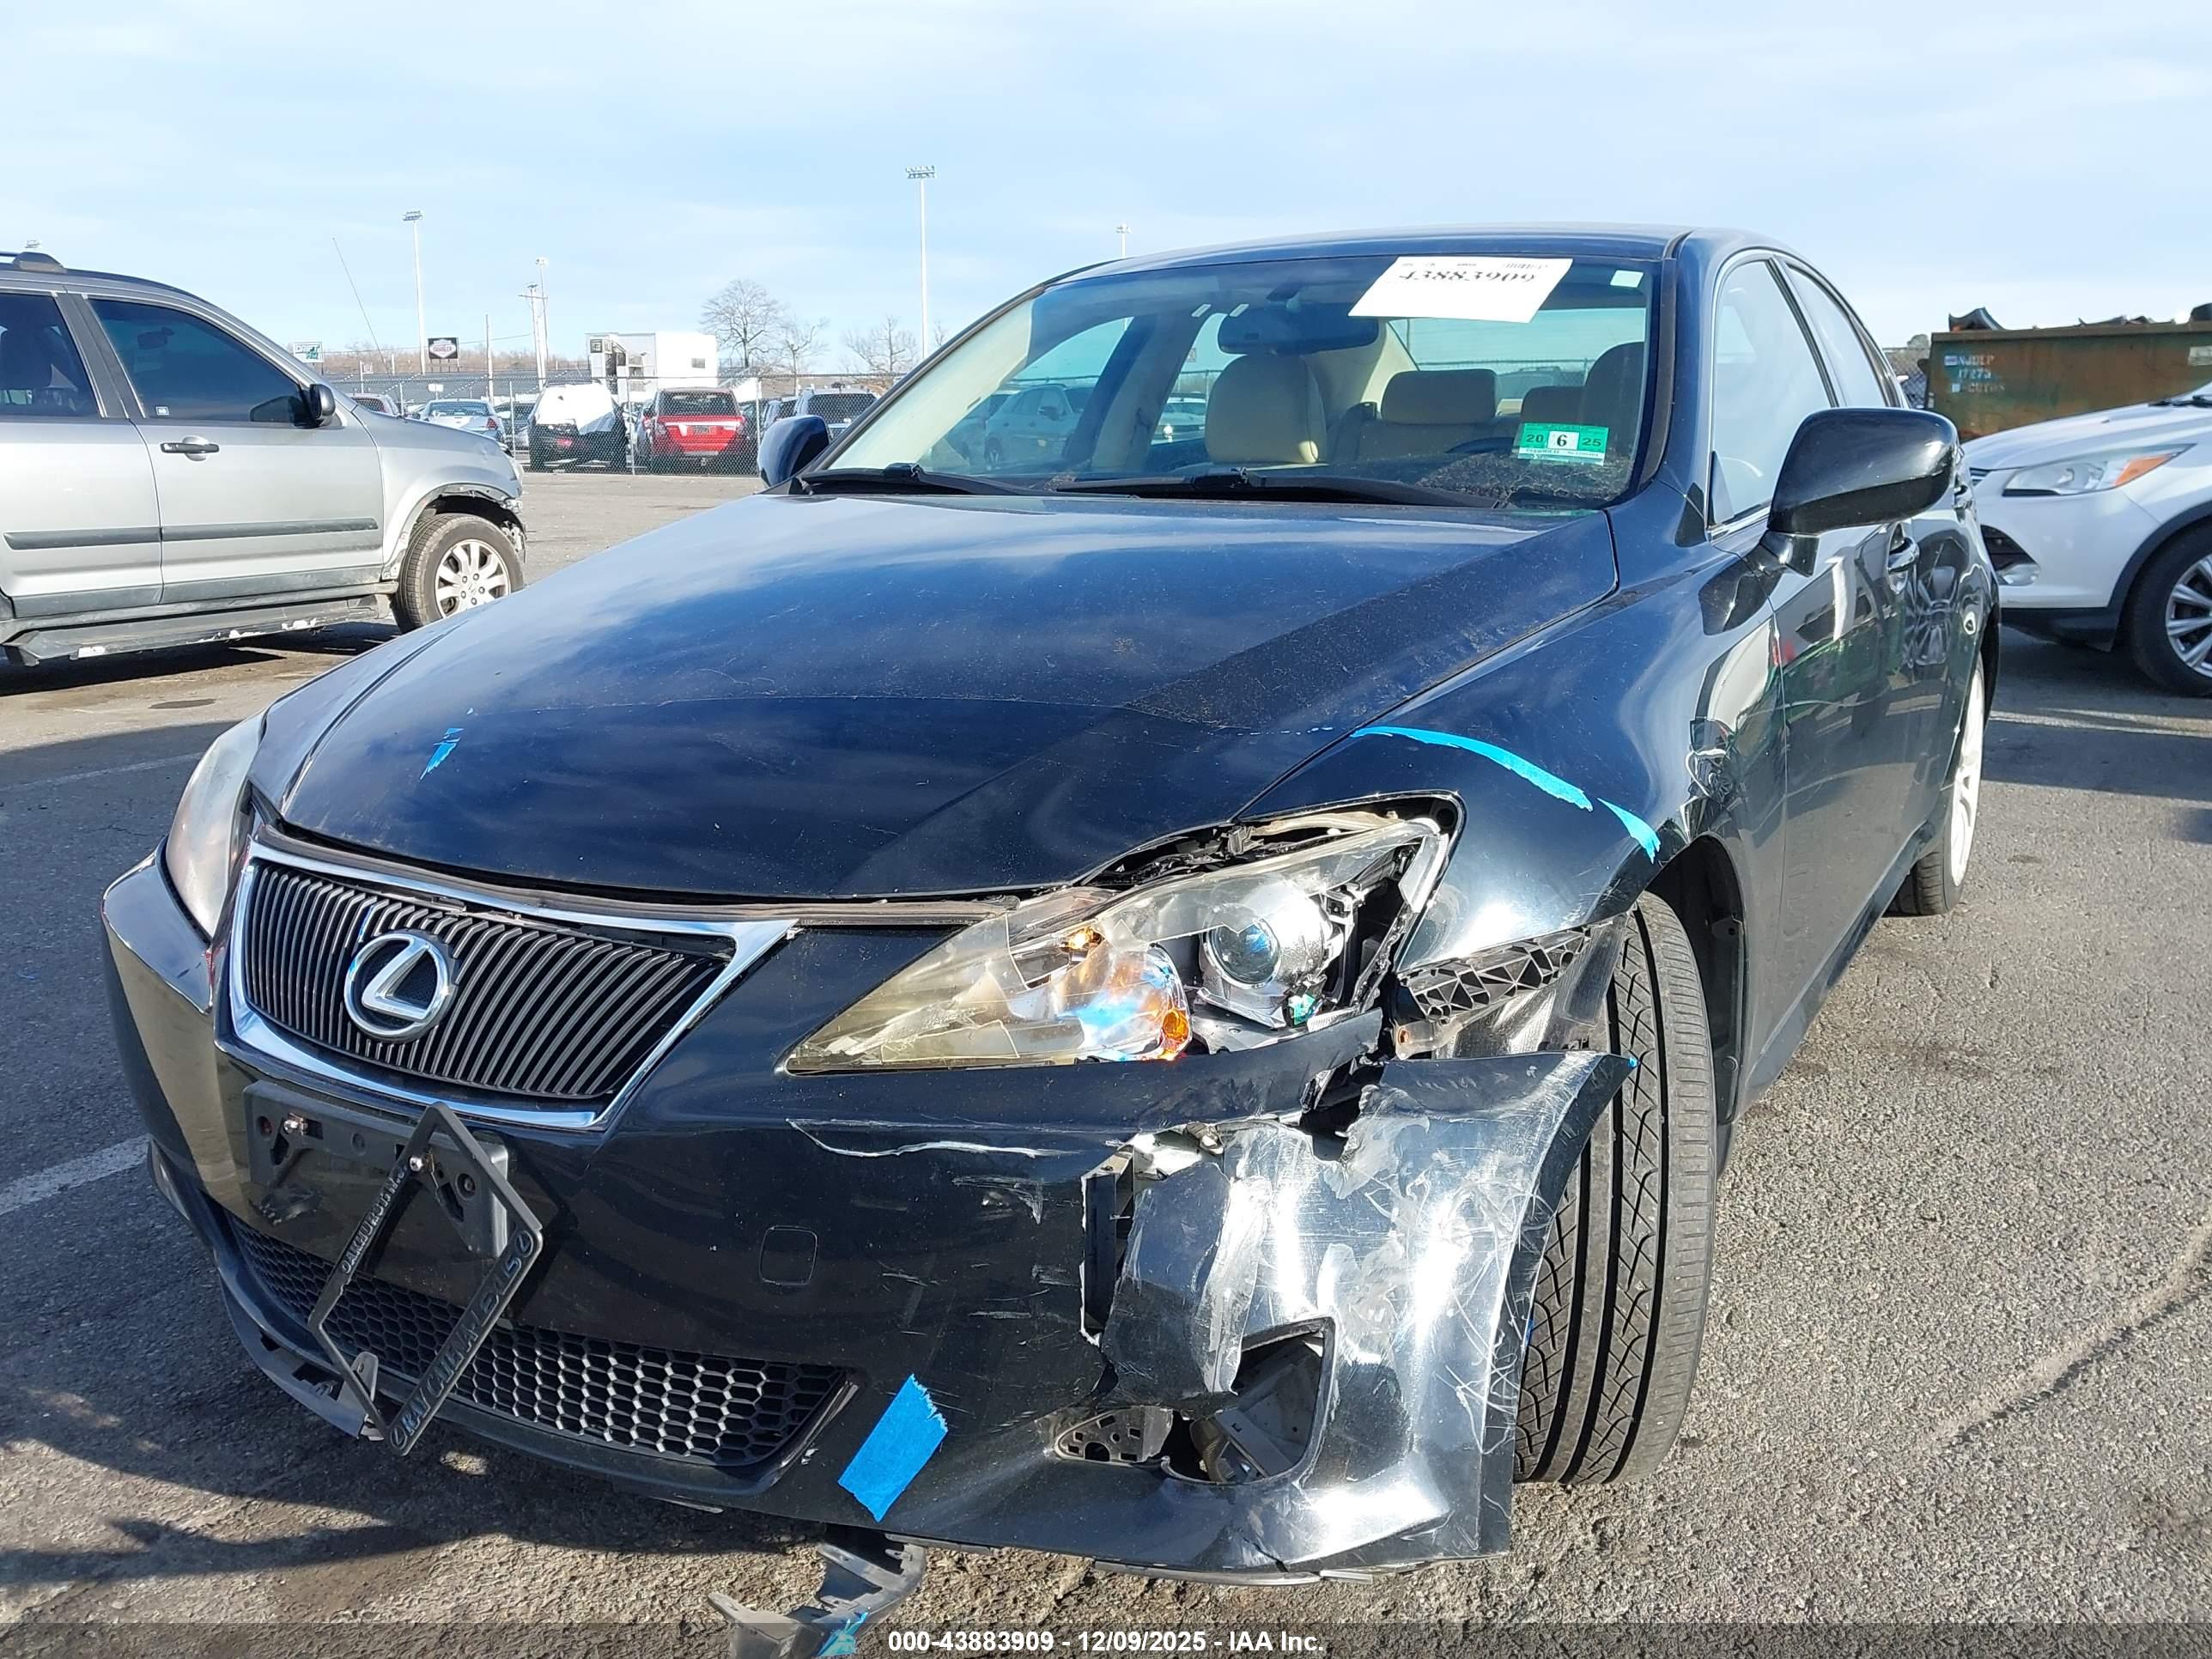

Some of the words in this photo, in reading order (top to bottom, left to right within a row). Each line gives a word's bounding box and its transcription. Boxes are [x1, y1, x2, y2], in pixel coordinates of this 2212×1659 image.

[1525, 434, 1544, 443] 20
[1556, 434, 1568, 447] 6
[1582, 437, 1601, 447] 25
